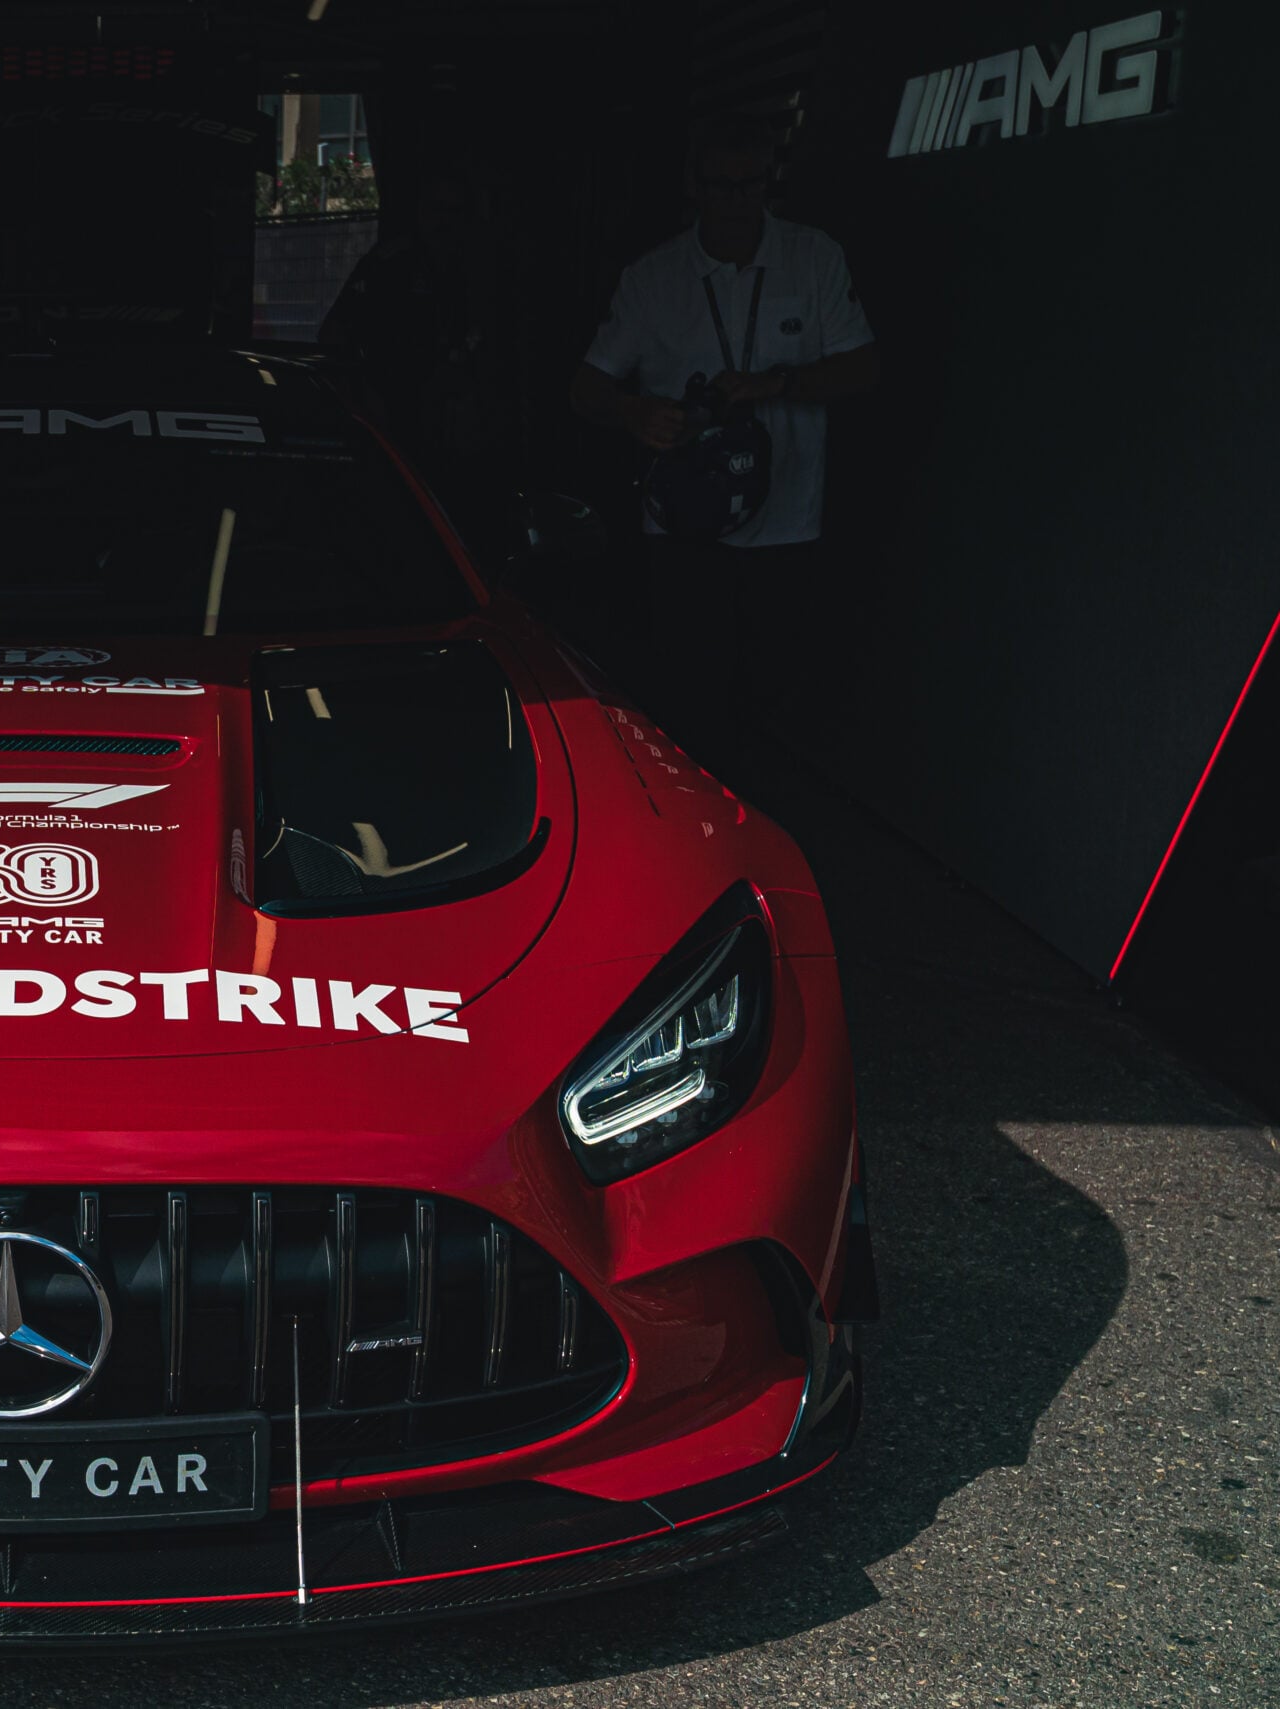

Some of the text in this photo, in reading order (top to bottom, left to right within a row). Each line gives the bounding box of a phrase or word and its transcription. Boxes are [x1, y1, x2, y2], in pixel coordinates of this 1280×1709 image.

[953, 9, 1163, 148] AMG
[80, 101, 258, 145] Series
[21, 685, 103, 695] Safely
[81, 676, 205, 689] CAR
[71, 814, 82, 822] 1
[5, 821, 163, 832] Championship
[38, 856, 57, 890] YRS
[44, 930, 104, 945] CAR
[85, 1452, 208, 1497] CAR
